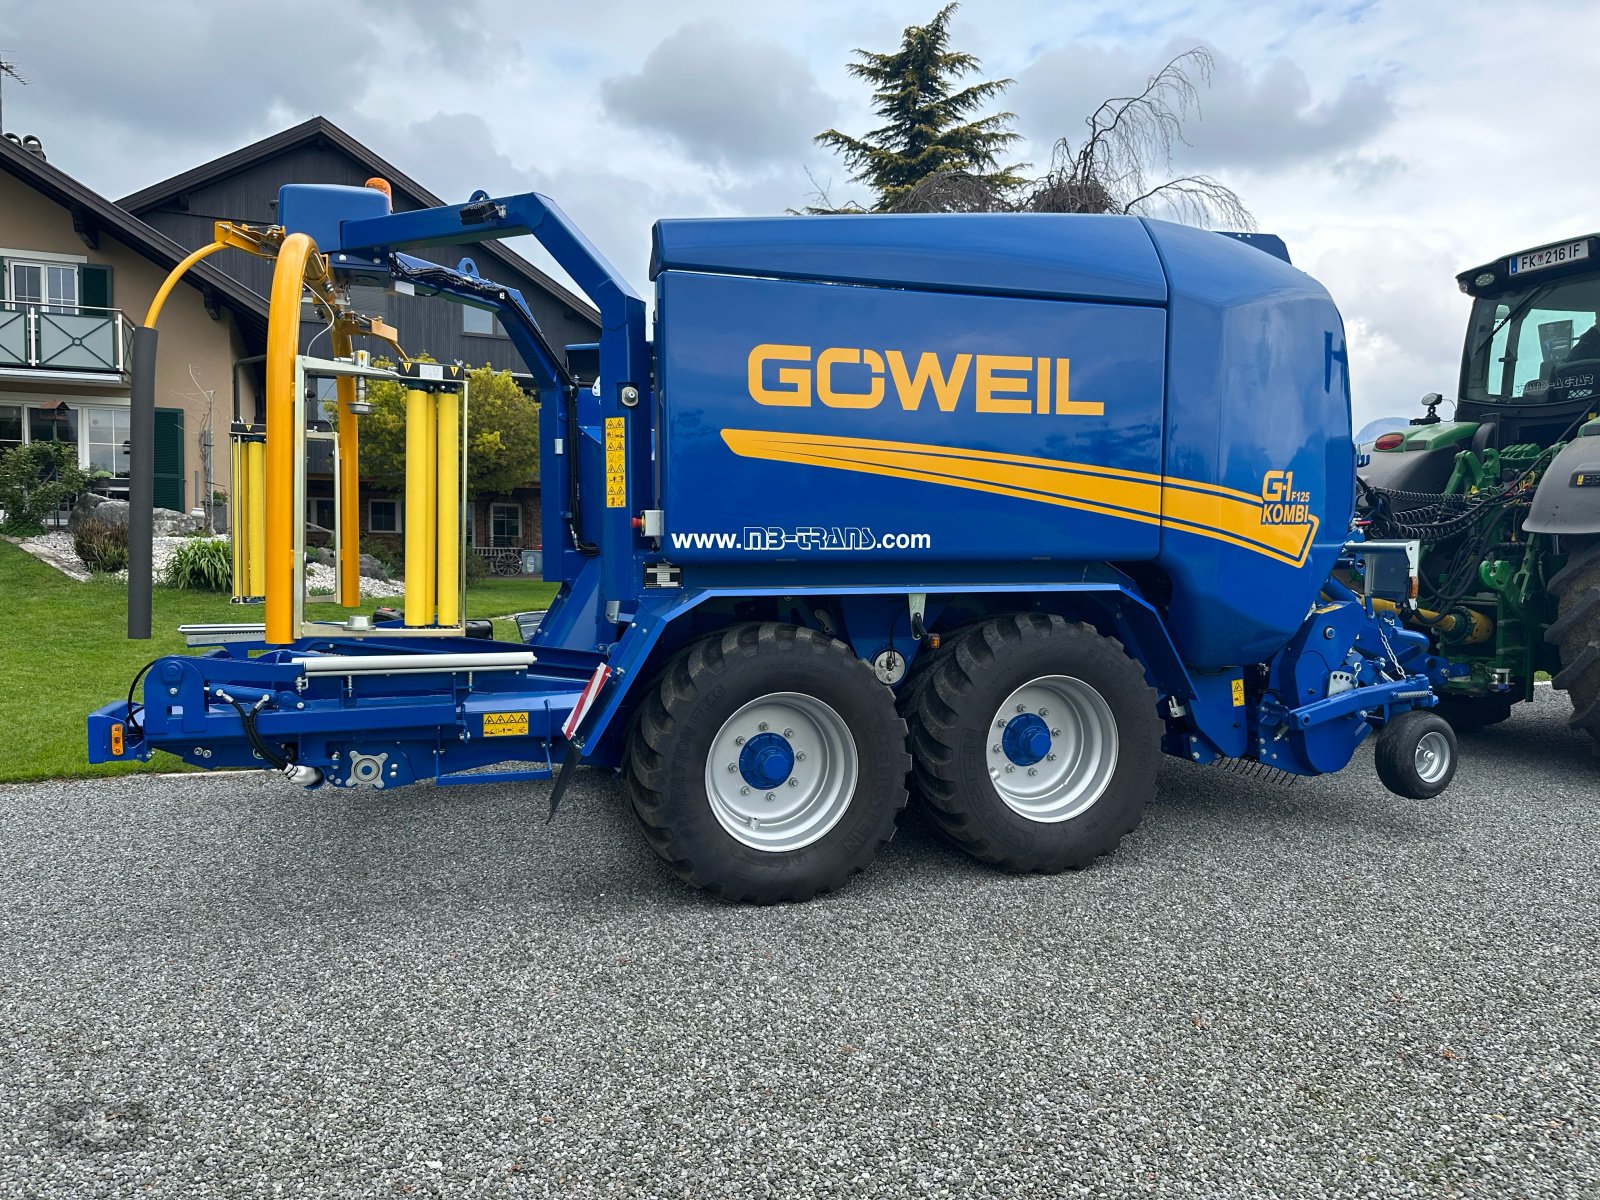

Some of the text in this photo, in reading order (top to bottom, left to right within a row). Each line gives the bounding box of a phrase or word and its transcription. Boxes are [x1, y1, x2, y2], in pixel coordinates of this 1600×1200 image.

[1521, 254, 1536, 270] FK
[1545, 247, 1566, 264] 216
[1568, 243, 1581, 258] IF
[1292, 491, 1311, 503] F125
[1262, 504, 1309, 523] KOMBI
